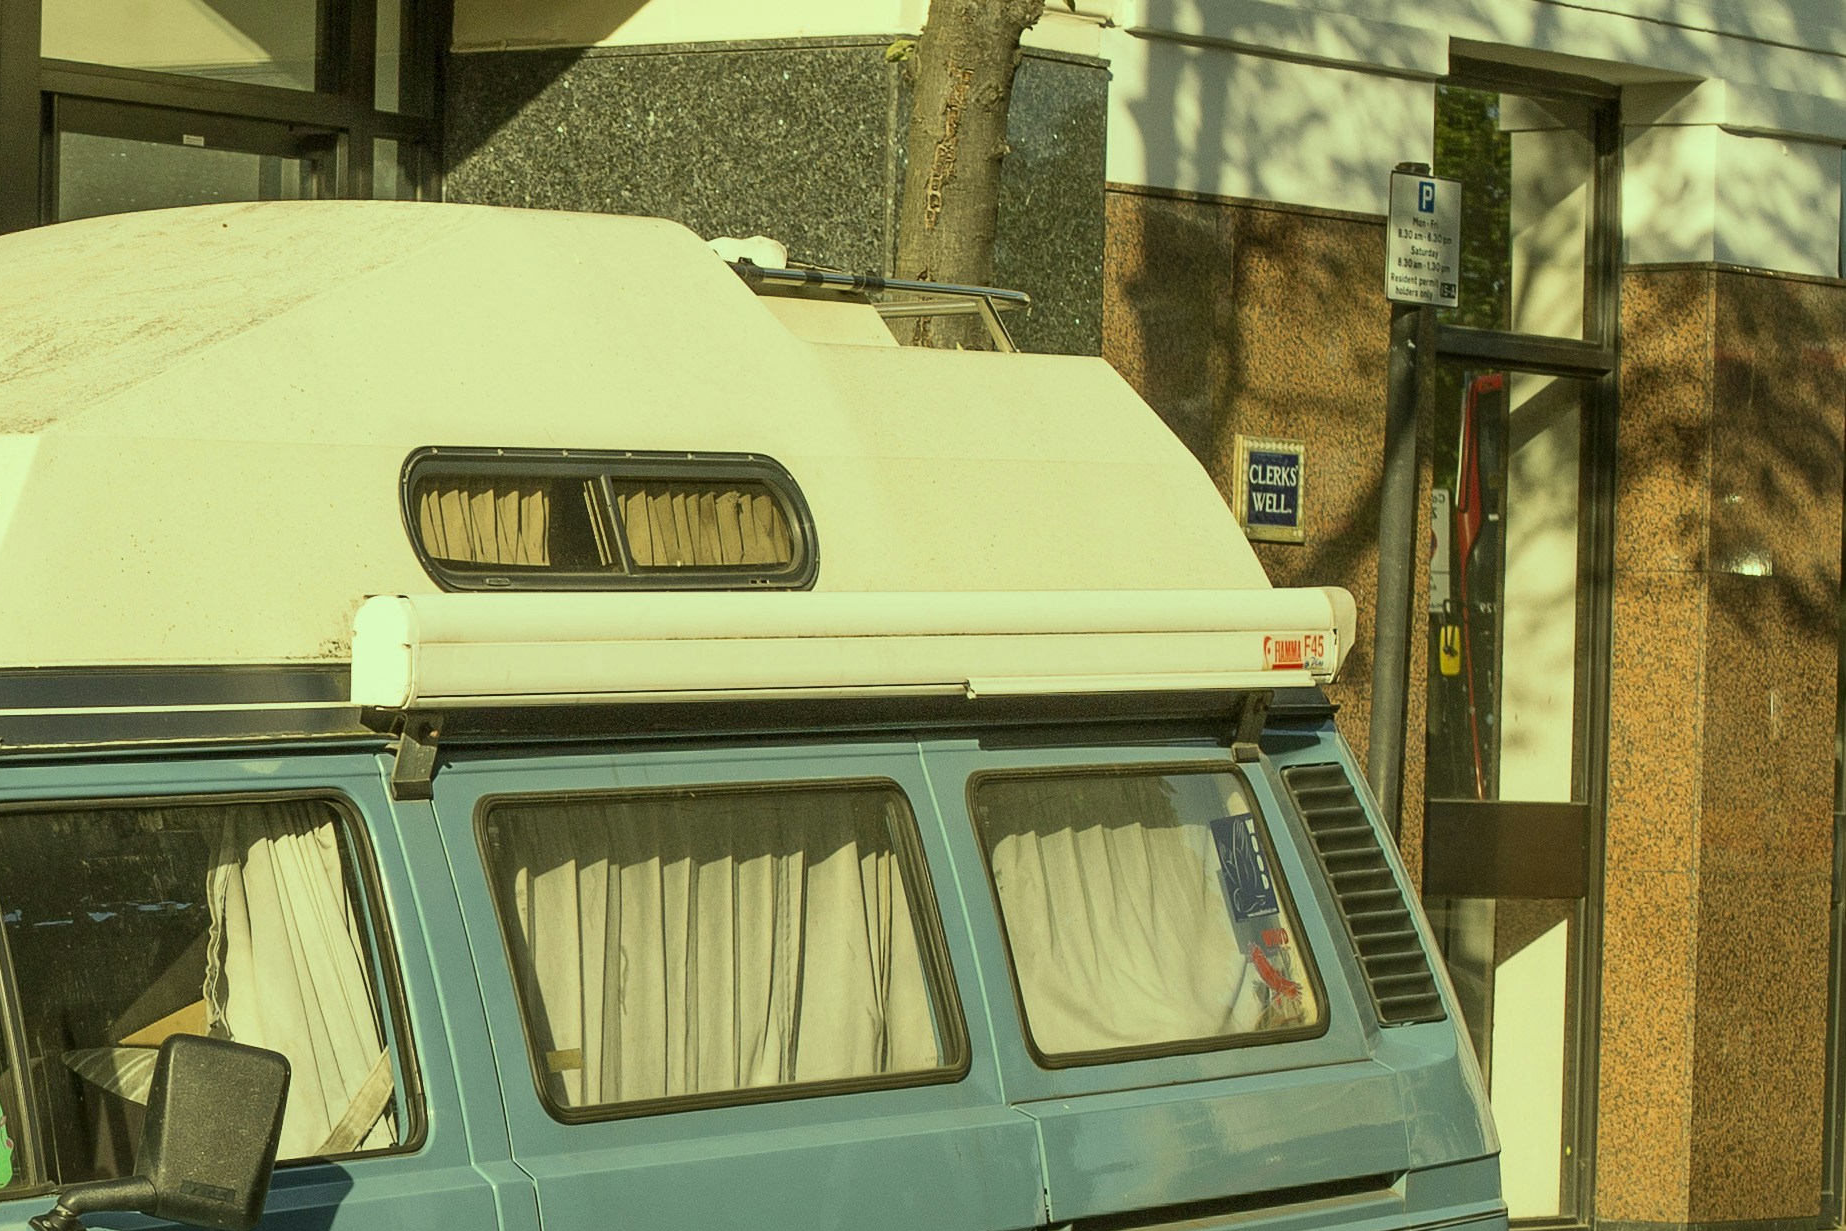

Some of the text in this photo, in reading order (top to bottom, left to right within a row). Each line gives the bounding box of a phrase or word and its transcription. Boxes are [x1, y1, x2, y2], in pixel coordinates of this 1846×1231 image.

[1422, 184, 1433, 210] P
[1410, 245, 1439, 260] Saturday
[1390, 272, 1440, 289] Resident permit
[1395, 285, 1433, 301] holders only
[1249, 463, 1299, 487] CLERKS'
[1304, 635, 1324, 658] F45
[1245, 818, 1270, 890] WOOD
